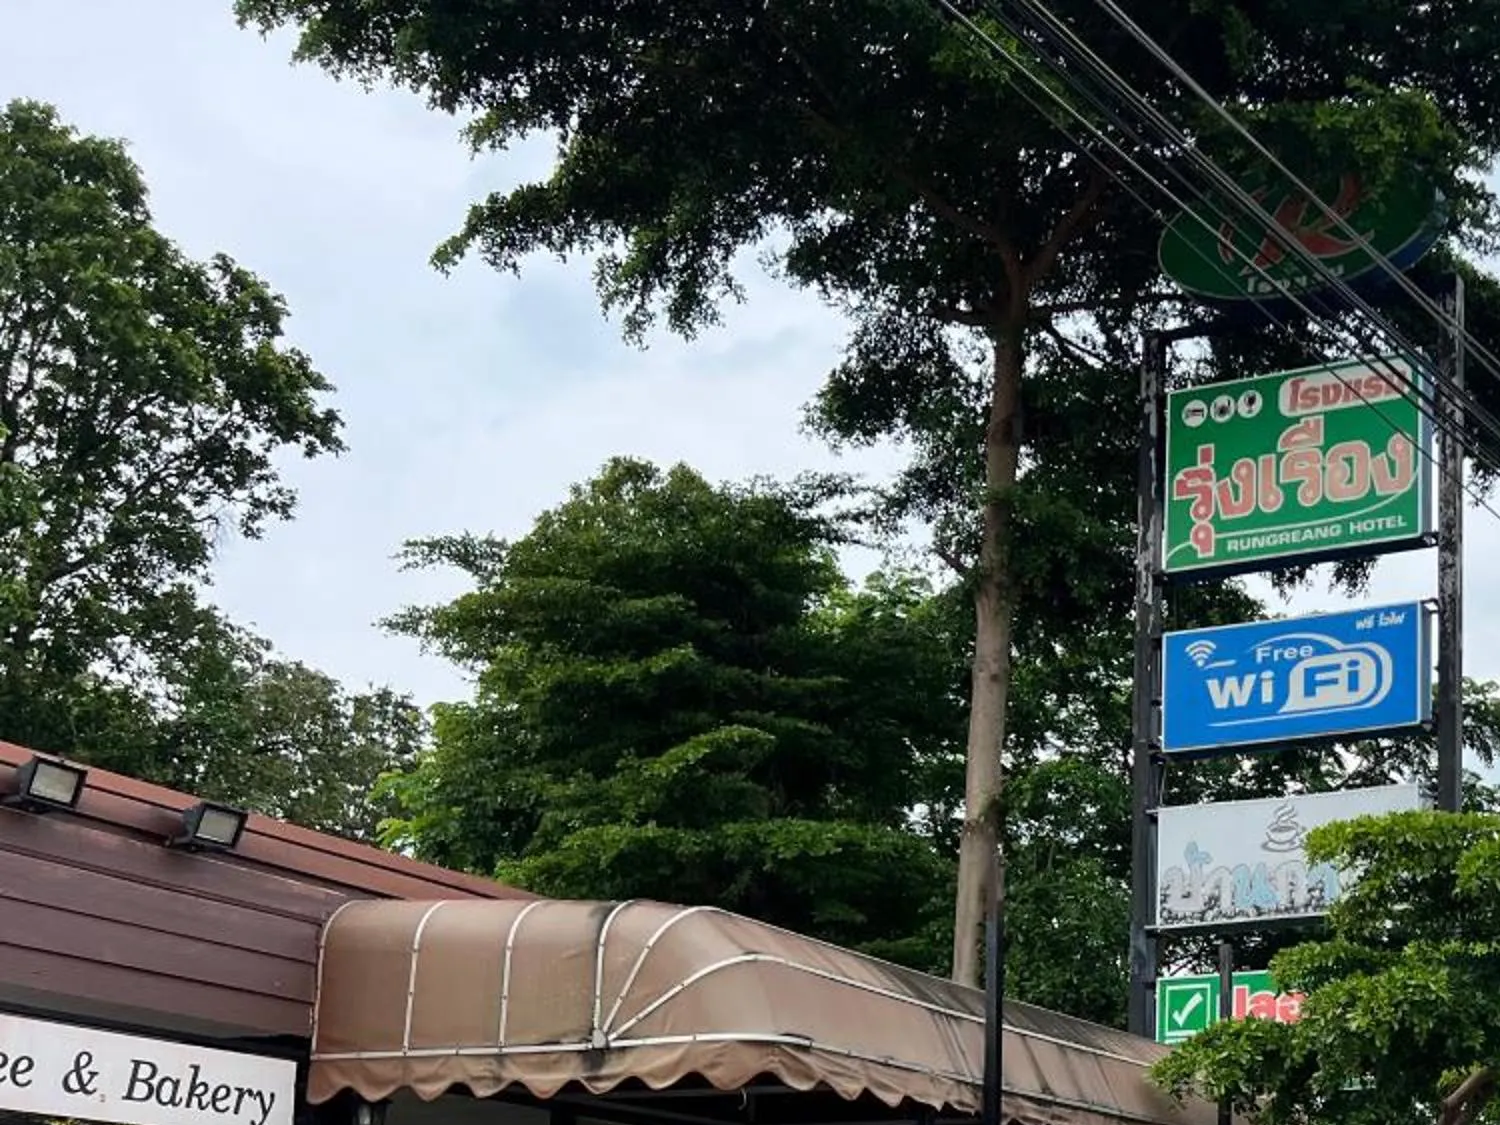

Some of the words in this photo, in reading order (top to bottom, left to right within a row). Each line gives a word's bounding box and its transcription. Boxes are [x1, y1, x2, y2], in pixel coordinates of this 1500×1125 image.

[1174, 415, 1413, 557] รุ่งเรือง
[1227, 525, 1342, 552] RUNGREANG
[1349, 515, 1408, 534] HOTEL
[1256, 645, 1314, 663] Free
[62, 1050, 99, 1095] &
